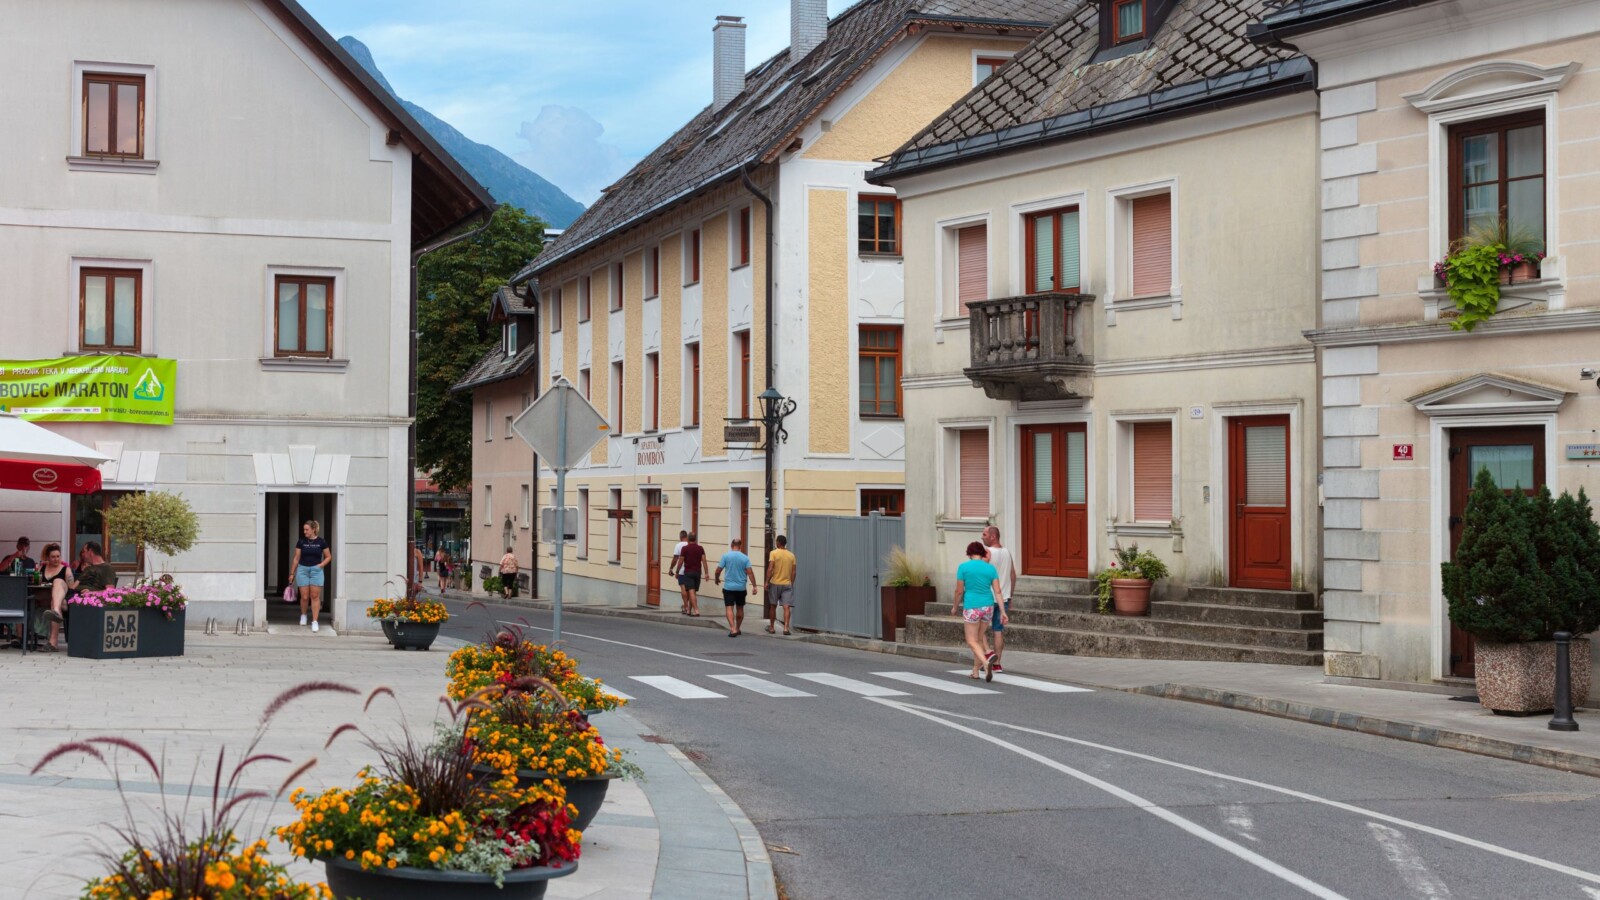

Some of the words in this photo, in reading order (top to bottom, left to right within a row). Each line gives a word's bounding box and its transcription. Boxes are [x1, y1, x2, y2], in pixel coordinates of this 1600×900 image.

[60, 367, 65, 375] V
[105, 366, 129, 374] NARAVI
[0, 383, 49, 398] BOVEC
[54, 382, 129, 398] MARATON
[1397, 445, 1408, 454] 40
[637, 451, 665, 466] ROMBON
[106, 614, 137, 634] BAR
[105, 634, 137, 649] gouf
